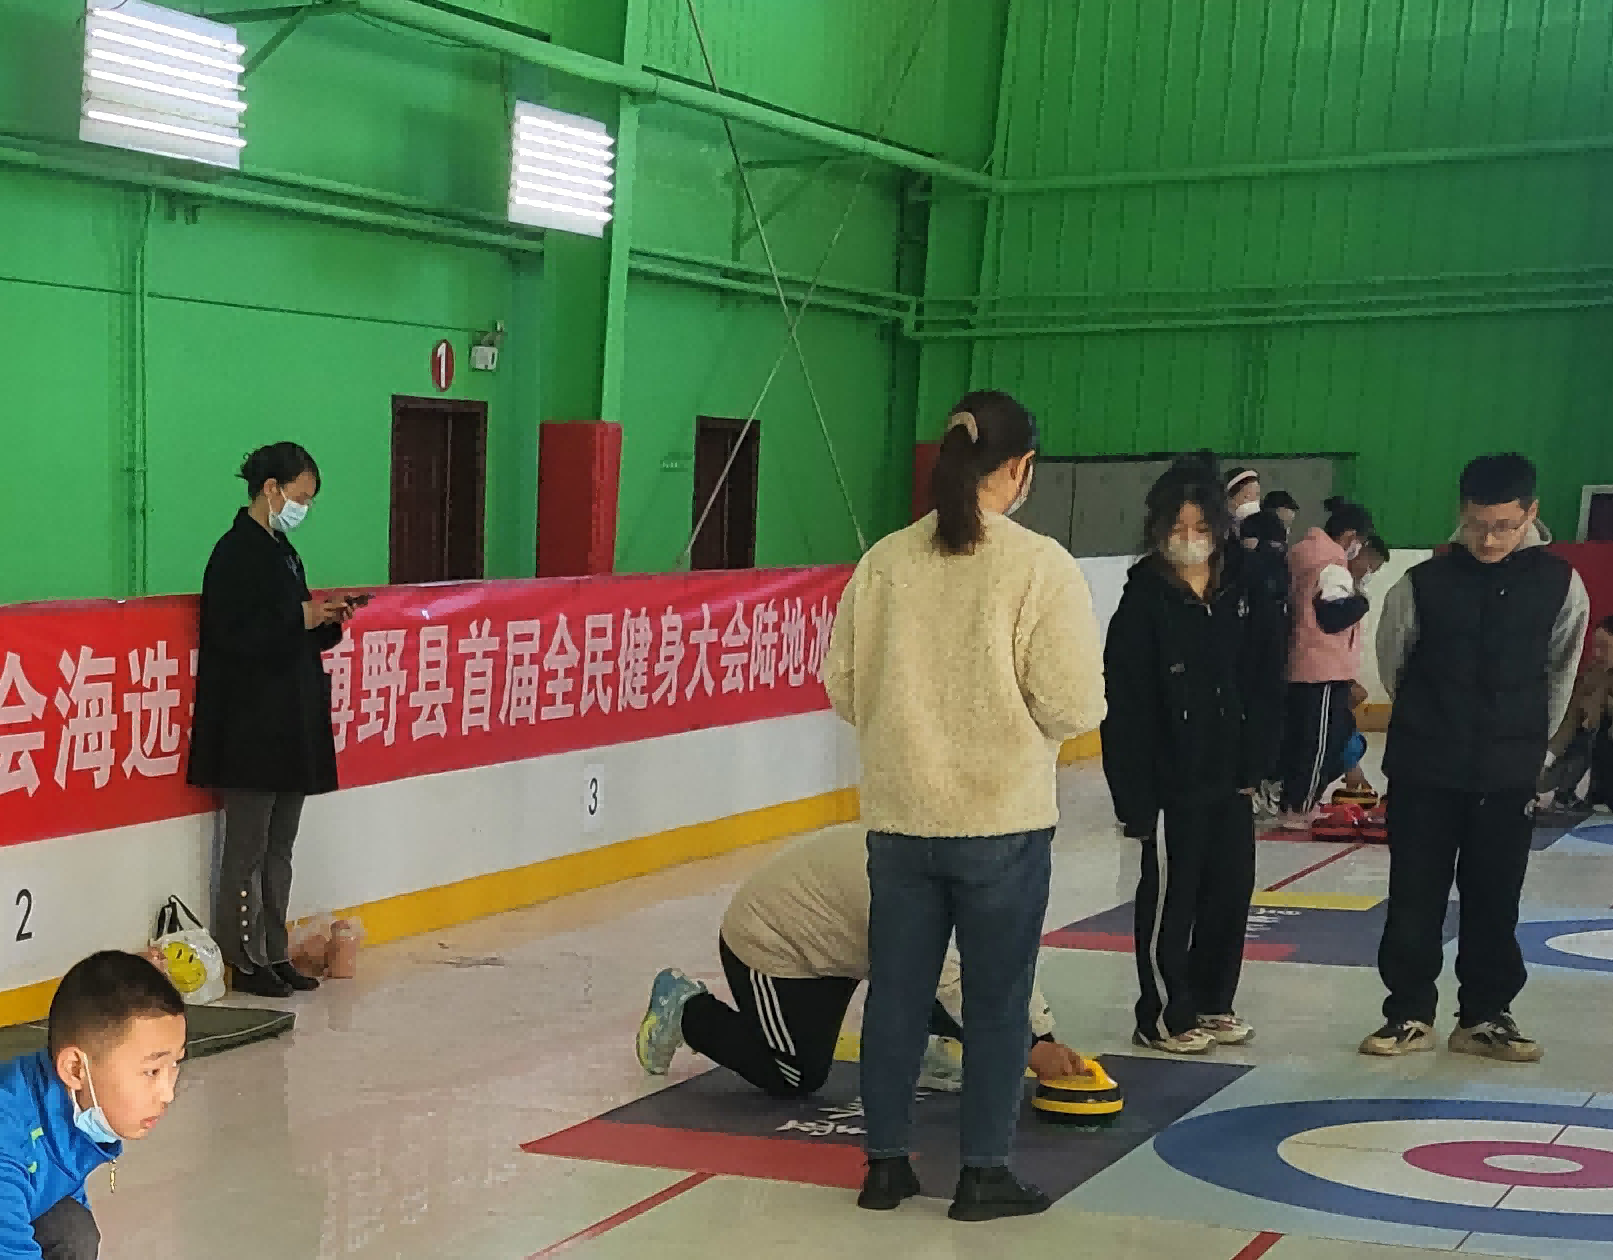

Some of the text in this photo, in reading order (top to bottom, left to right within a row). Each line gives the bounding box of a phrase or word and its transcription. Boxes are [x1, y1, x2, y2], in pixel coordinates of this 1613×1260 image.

[437, 341, 447, 389] 1
[588, 777, 598, 816] 3
[15, 888, 33, 942] 2
